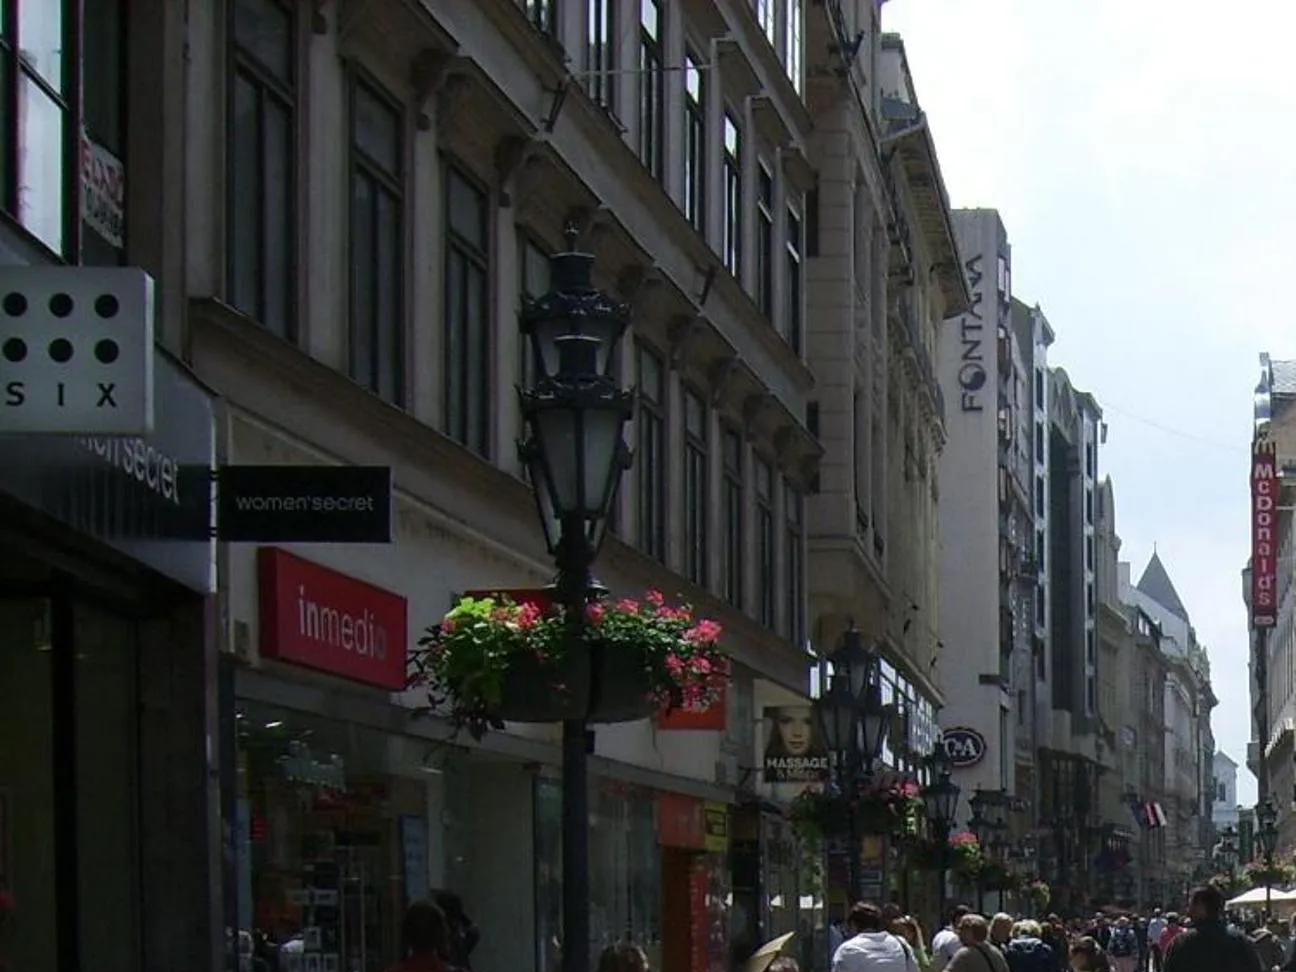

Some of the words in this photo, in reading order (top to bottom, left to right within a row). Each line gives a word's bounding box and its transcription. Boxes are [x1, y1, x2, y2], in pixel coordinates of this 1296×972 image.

[6, 382, 117, 407] SIX
[233, 493, 375, 513] women'secret
[766, 757, 829, 769] MASSAGE
